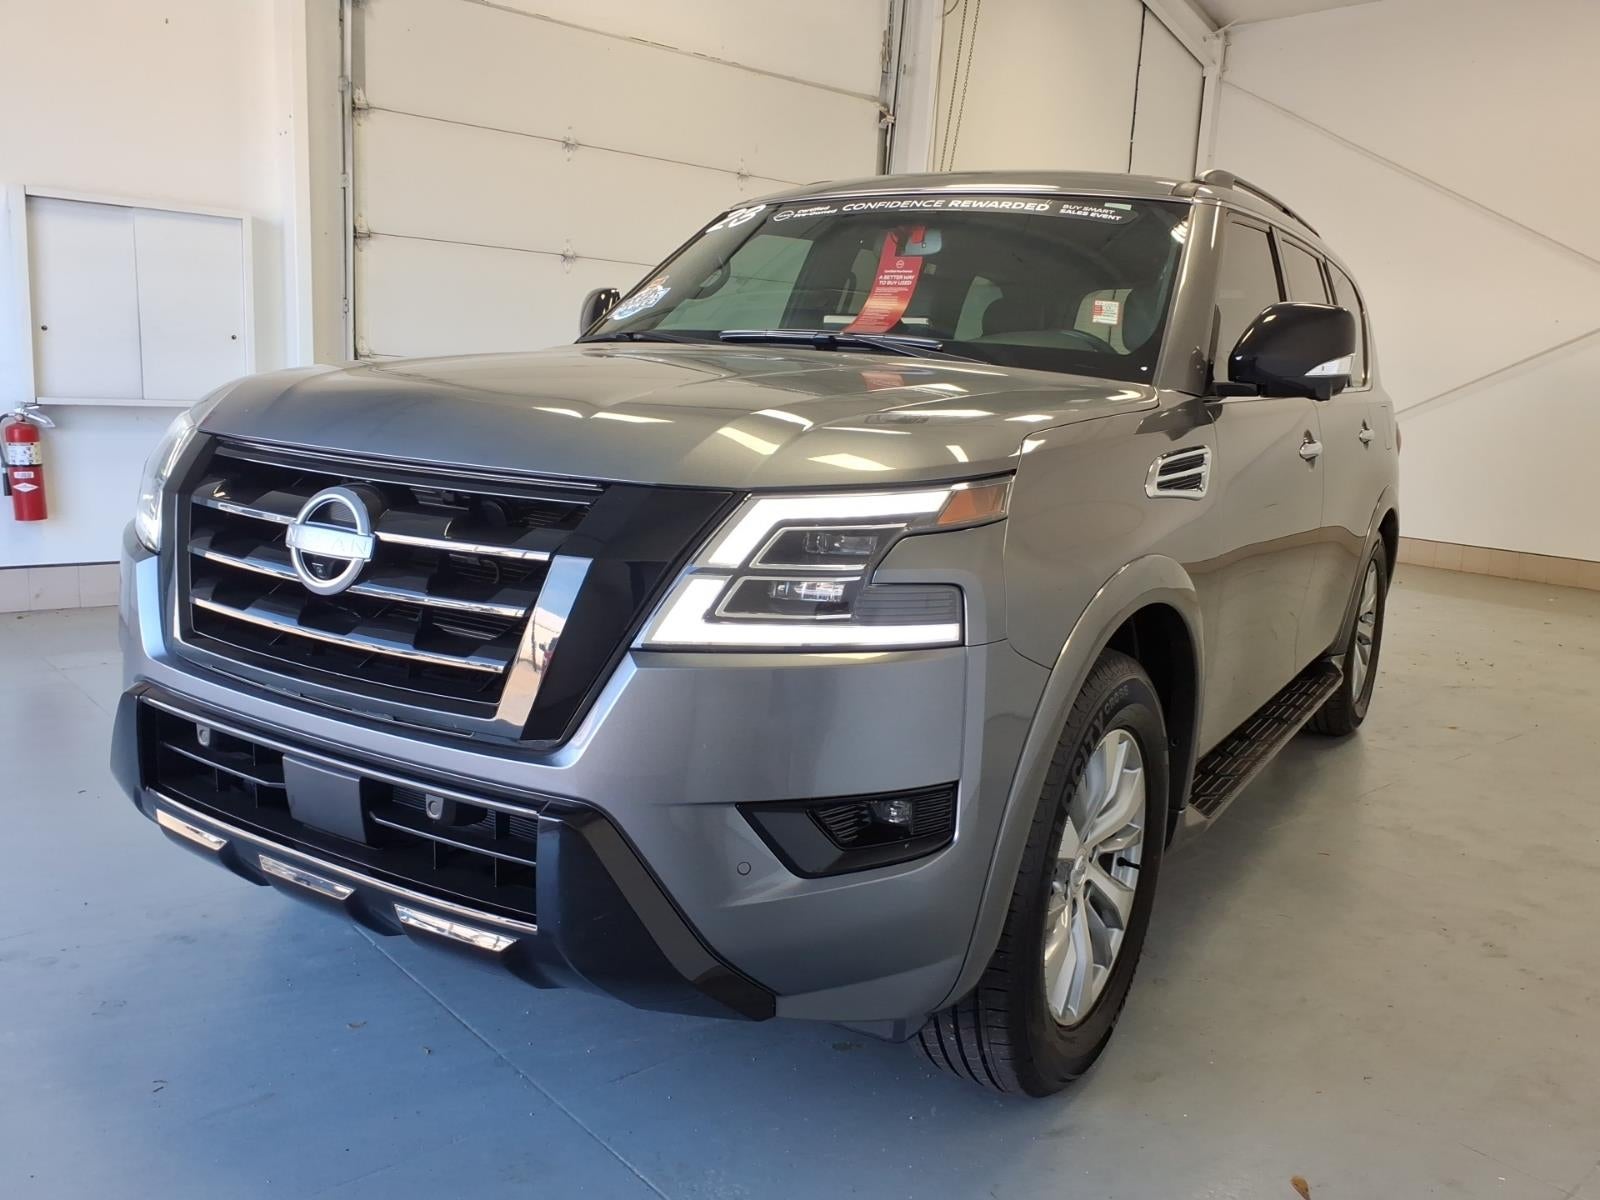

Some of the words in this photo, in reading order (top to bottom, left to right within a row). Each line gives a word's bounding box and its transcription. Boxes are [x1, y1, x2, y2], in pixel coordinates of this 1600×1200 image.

[842, 200, 945, 211] CONFIDENCE
[949, 200, 1049, 211] REWARDED
[1062, 203, 1082, 211] BUY
[1084, 206, 1115, 214] SMART
[1059, 208, 1088, 217] SALES
[1090, 212, 1122, 221] EVENT
